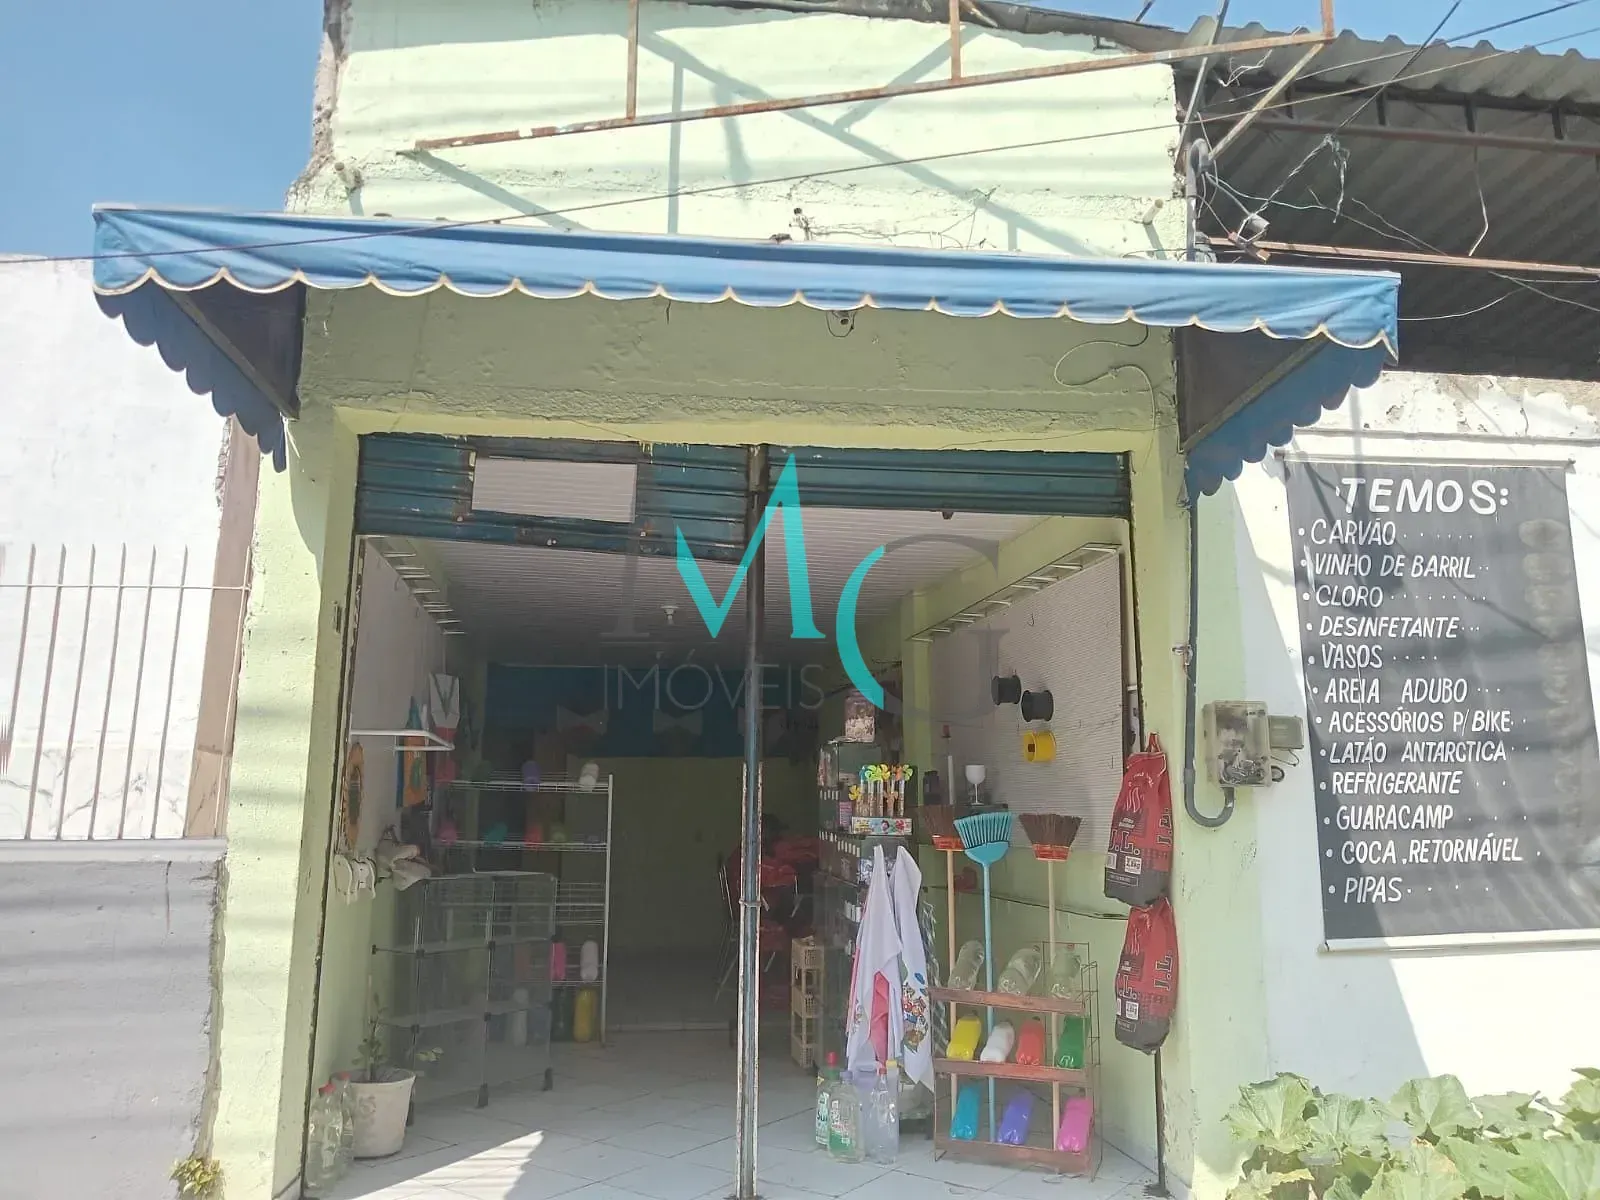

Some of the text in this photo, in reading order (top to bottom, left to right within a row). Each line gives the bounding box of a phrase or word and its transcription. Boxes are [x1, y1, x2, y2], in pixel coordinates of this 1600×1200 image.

[1310, 518, 1396, 546] CARVÃO
[1314, 553, 1476, 579] VINHO DE BARRIL
[1315, 585, 1384, 608] CLORO
[1319, 615, 1460, 638] DESINFETANTE
[1321, 643, 1384, 669] VASOS
[1324, 677, 1468, 704] AREIA ADUBO
[1328, 706, 1444, 734] ACESSÓRIOS
[1400, 741, 1507, 763] ANTARCTICA
[1332, 770, 1464, 795] REFRIGERANTE
[1336, 804, 1454, 830] GUARACAMP
[1340, 840, 1397, 865] COCA
[1344, 876, 1403, 904] PIPAS
